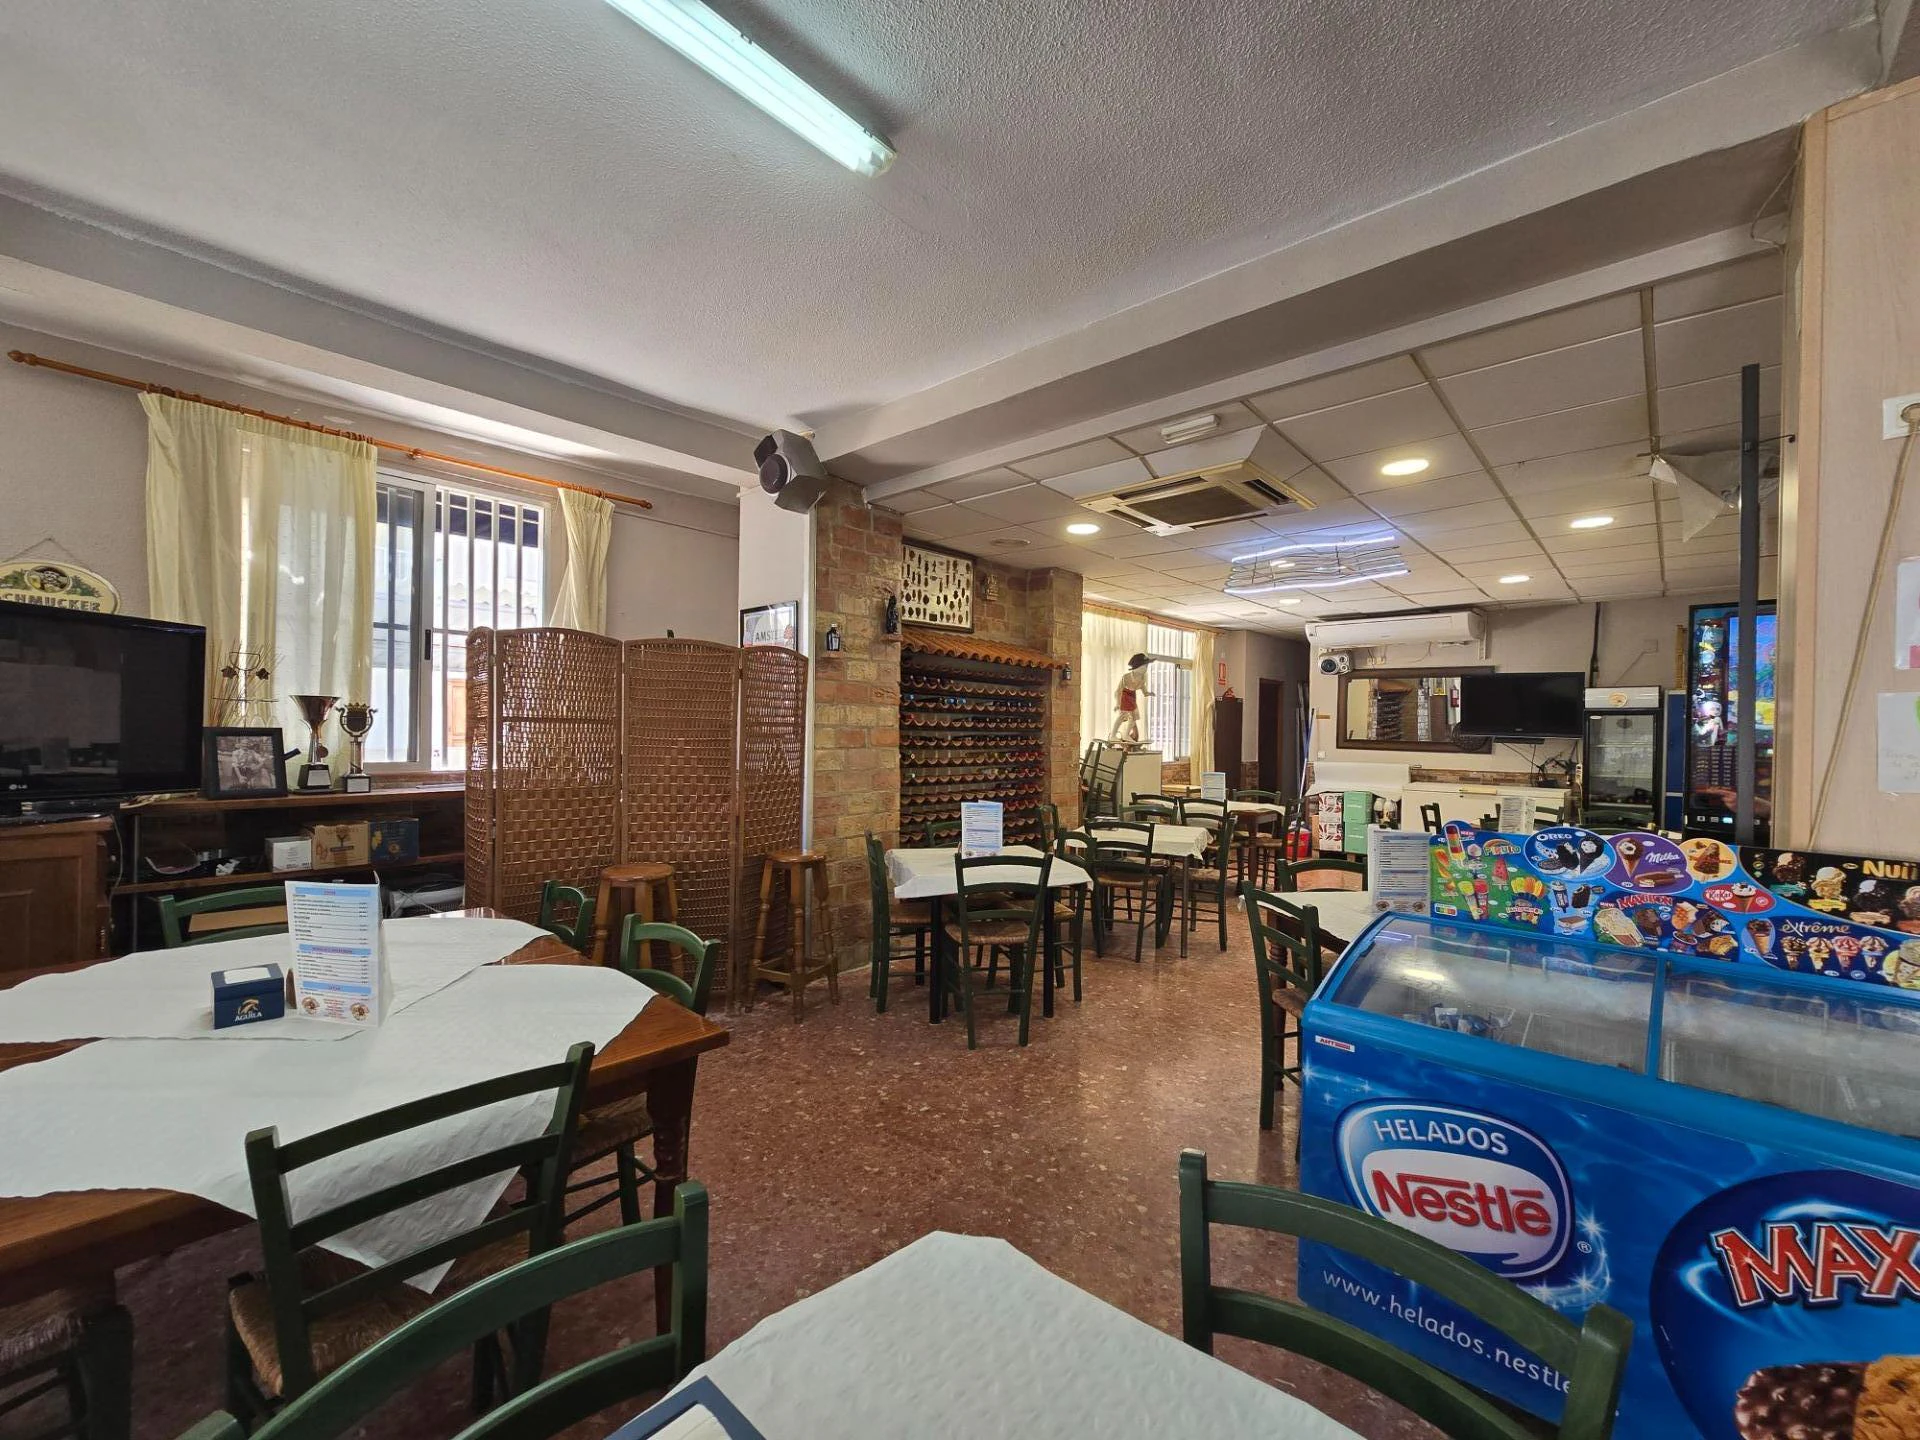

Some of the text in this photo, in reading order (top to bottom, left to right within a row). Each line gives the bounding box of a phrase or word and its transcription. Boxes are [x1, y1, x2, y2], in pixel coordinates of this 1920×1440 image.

[0, 592, 101, 612] CHMUCKER
[1536, 832, 1573, 842] OREO
[1645, 851, 1681, 864] Milka
[1373, 1119, 1510, 1155] HELADOS
